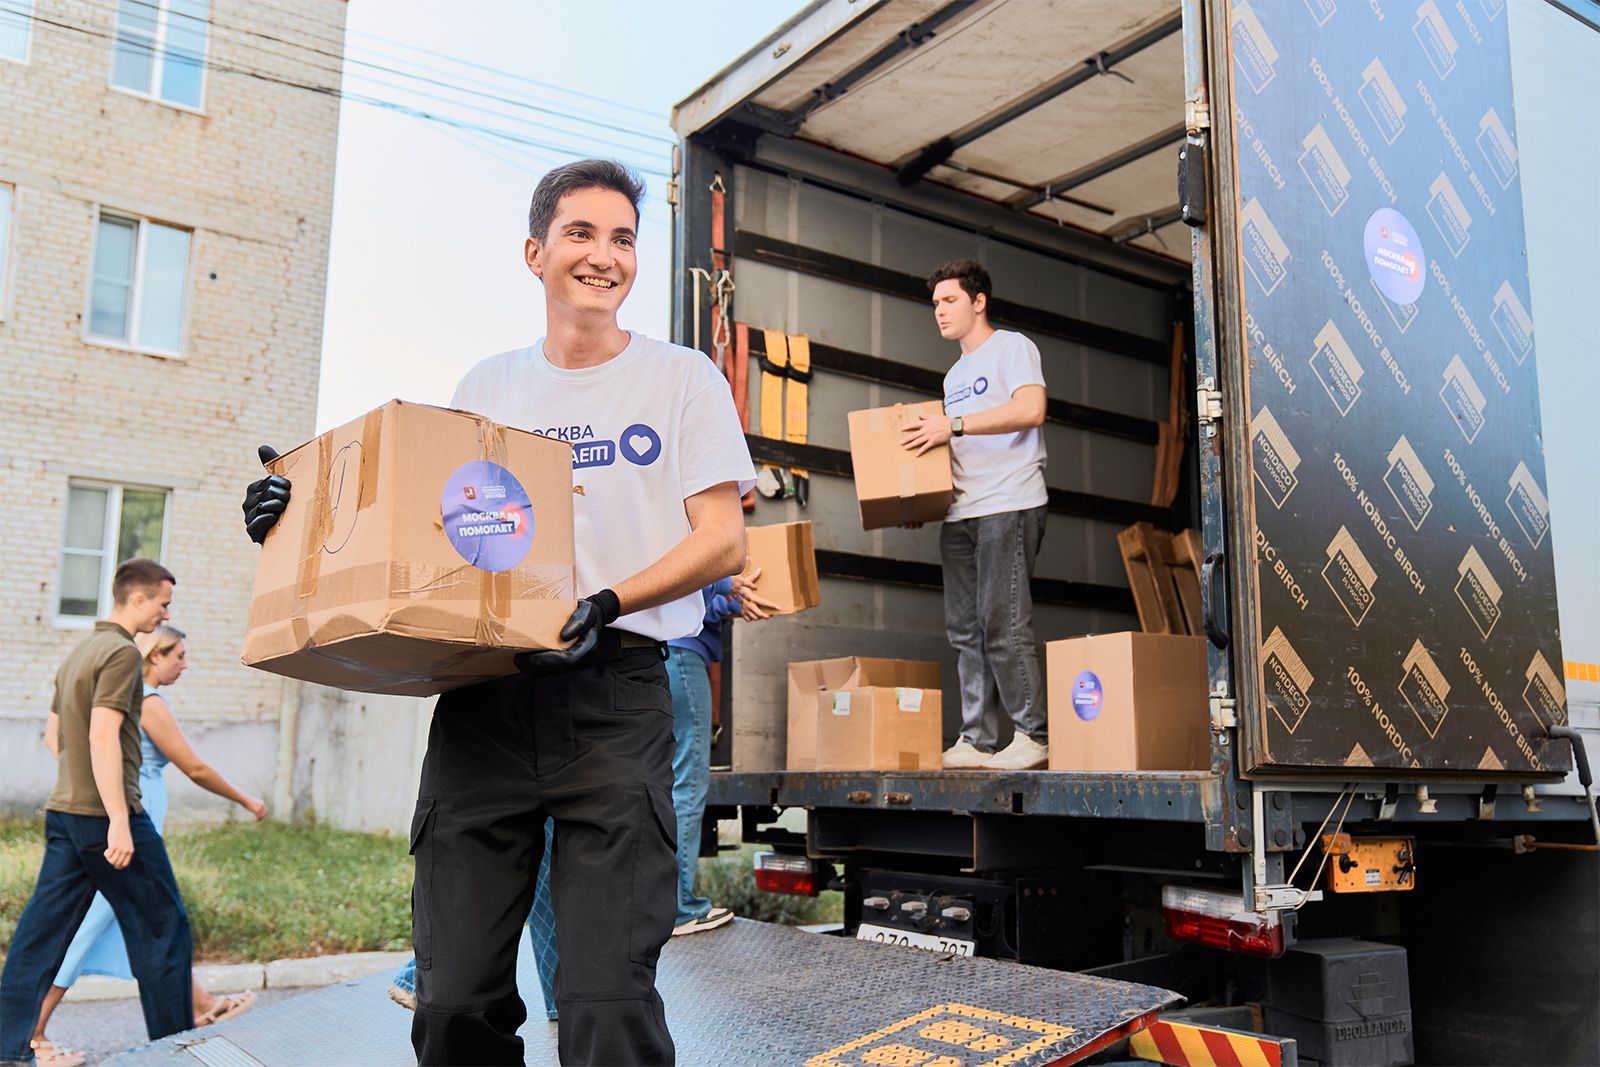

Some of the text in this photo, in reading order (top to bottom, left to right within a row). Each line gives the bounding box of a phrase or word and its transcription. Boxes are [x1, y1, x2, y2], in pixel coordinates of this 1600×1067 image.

[1235, 23, 1270, 76] NORDECO
[1371, 80, 1401, 128] NORDECO
[1235, 102, 1286, 190] DIC BIRCH
[1310, 56, 1397, 204] 100% NORDIC BIRCH
[1416, 79, 1496, 216] 100% NORDIC BIRCH
[1311, 148, 1344, 199] NORDECO
[1438, 194, 1466, 241] NORDECO
[1247, 223, 1281, 275] NORDECO
[1252, 246, 1275, 281] PLYWOOD
[1320, 249, 1346, 290] 100%
[1344, 288, 1382, 349] NORDIC
[1380, 346, 1411, 395] BIRCH
[1430, 259, 1511, 395] 100% NORDIC BIRCH
[1245, 309, 1297, 395] DIC BIRCH
[1323, 345, 1356, 396] NORDECO
[1328, 367, 1351, 403] PLYWOOD
[1451, 378, 1480, 425] NORDECO
[532, 424, 594, 441] СКВА
[1257, 434, 1292, 486] NORDECO
[1262, 457, 1287, 493] PLYWOOD
[1396, 462, 1428, 509] NORDECO
[1401, 482, 1424, 516] PLYWOOD
[1517, 485, 1545, 530] NORDECO
[459, 523, 513, 537] ПОМОГАЕТ
[462, 511, 506, 523] МОСКВА
[1332, 451, 1426, 596] 100% NORDIC BIRCH
[1443, 448, 1528, 583] 100% NORDIC BIRCH
[1256, 529, 1310, 611] DIC BIRCH
[1336, 554, 1370, 603] NORDECO
[1341, 576, 1365, 610] PLYWOOD
[1467, 571, 1496, 617] NORDECO
[1269, 657, 1305, 708] NORDECO
[1275, 681, 1300, 716] PLYWOOD
[1412, 667, 1443, 714] NORDECO
[1459, 647, 1483, 685] 100%
[1481, 680, 1519, 737] NORDIC
[1534, 677, 1561, 719] NORDECO
[1347, 666, 1412, 761] 100% NORDIC
[1336, 1018, 1407, 1041] DHOLLANDIA
